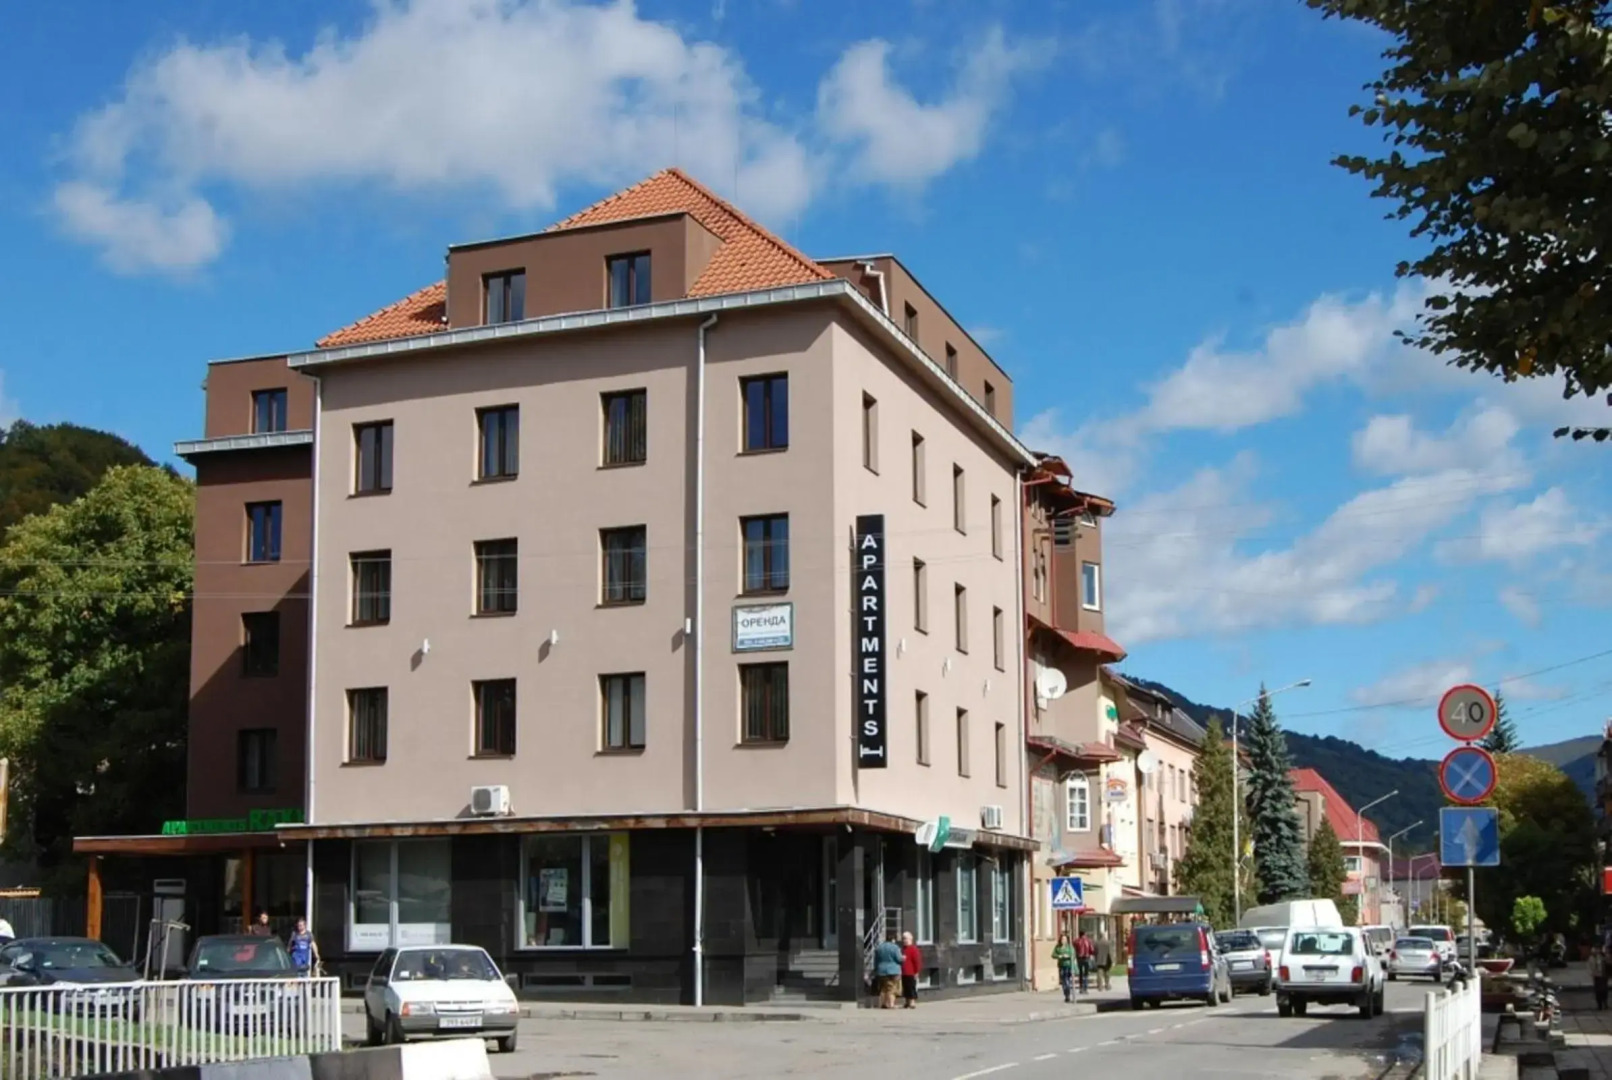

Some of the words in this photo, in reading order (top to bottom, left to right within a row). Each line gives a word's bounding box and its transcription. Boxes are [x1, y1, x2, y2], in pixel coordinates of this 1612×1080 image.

[741, 615, 786, 628] ОРЕНДА
[861, 533, 879, 737] APARTMENTS
[1451, 701, 1484, 725] 40
